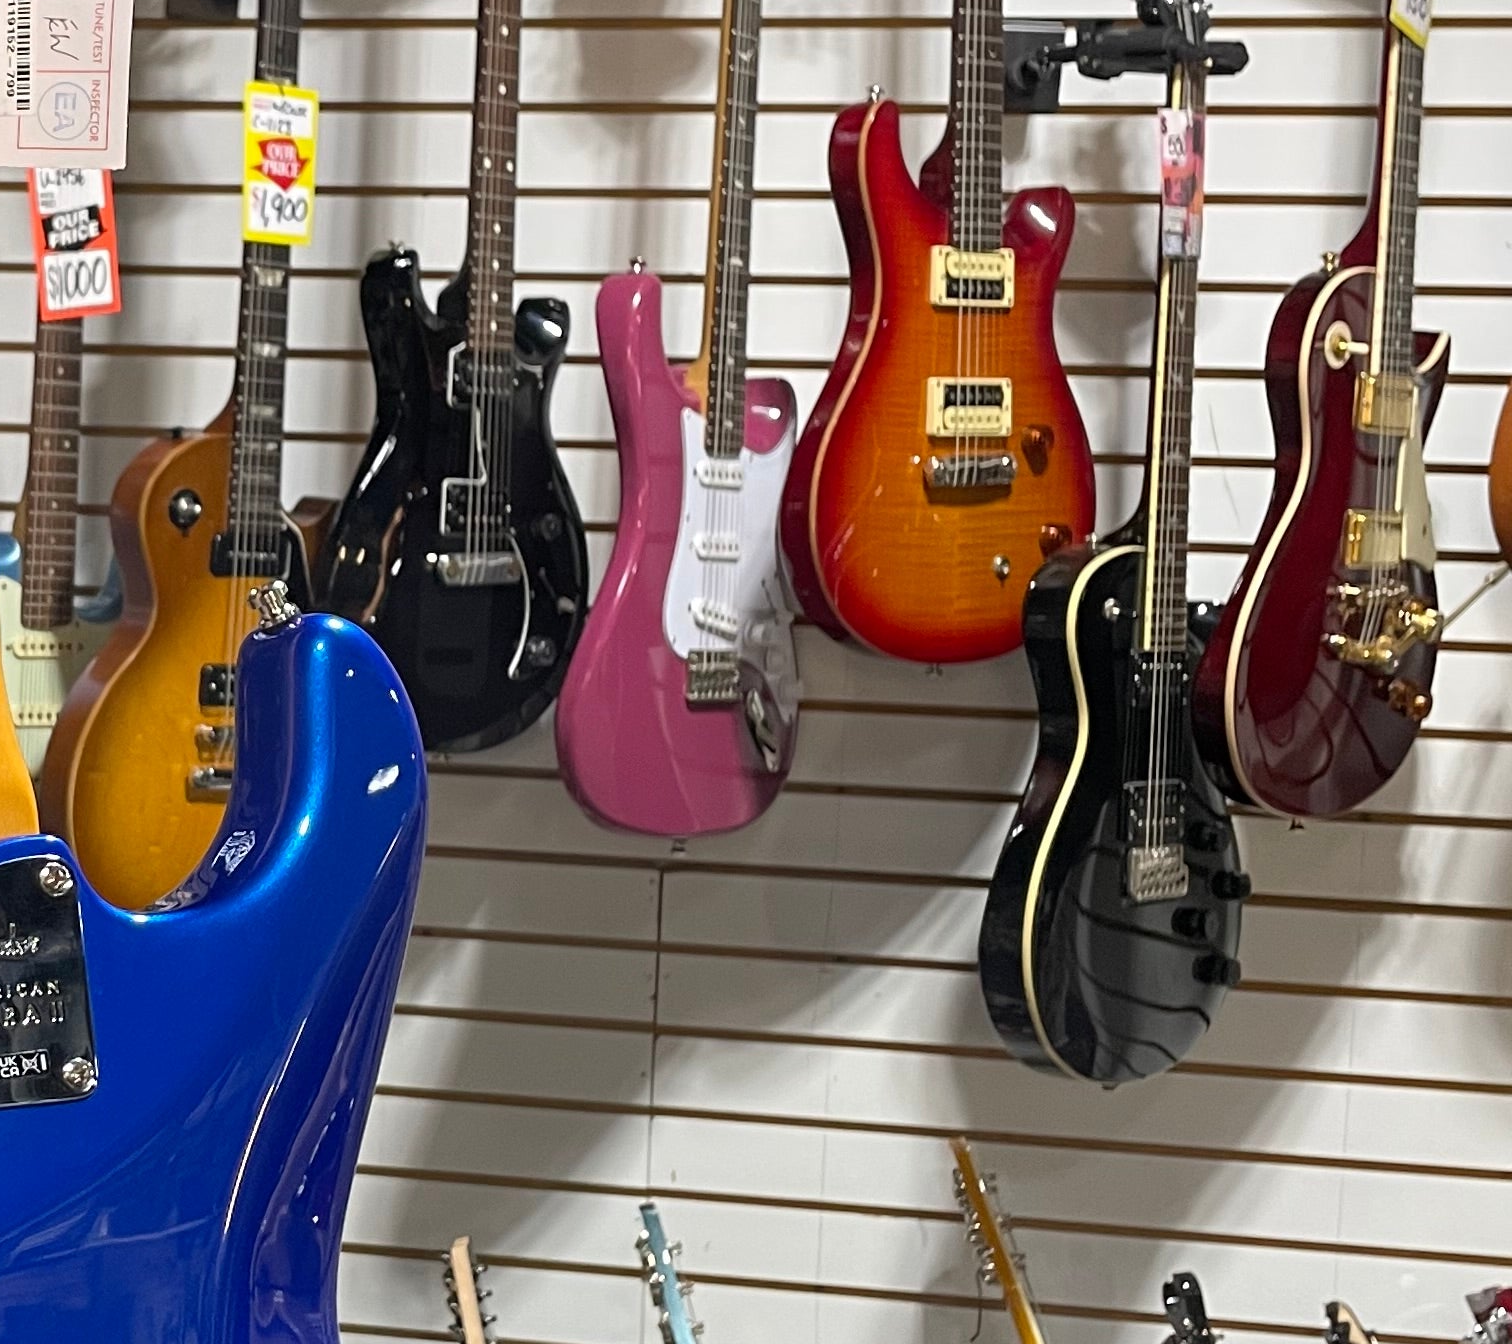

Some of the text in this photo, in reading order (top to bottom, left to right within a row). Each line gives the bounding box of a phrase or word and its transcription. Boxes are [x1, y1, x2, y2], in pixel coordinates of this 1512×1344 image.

[92, 1, 106, 64] TUNE/TEST
[88, 79, 101, 142] INSPECTOR
[47, 221, 100, 250] PRICE
[51, 208, 90, 232] OUR
